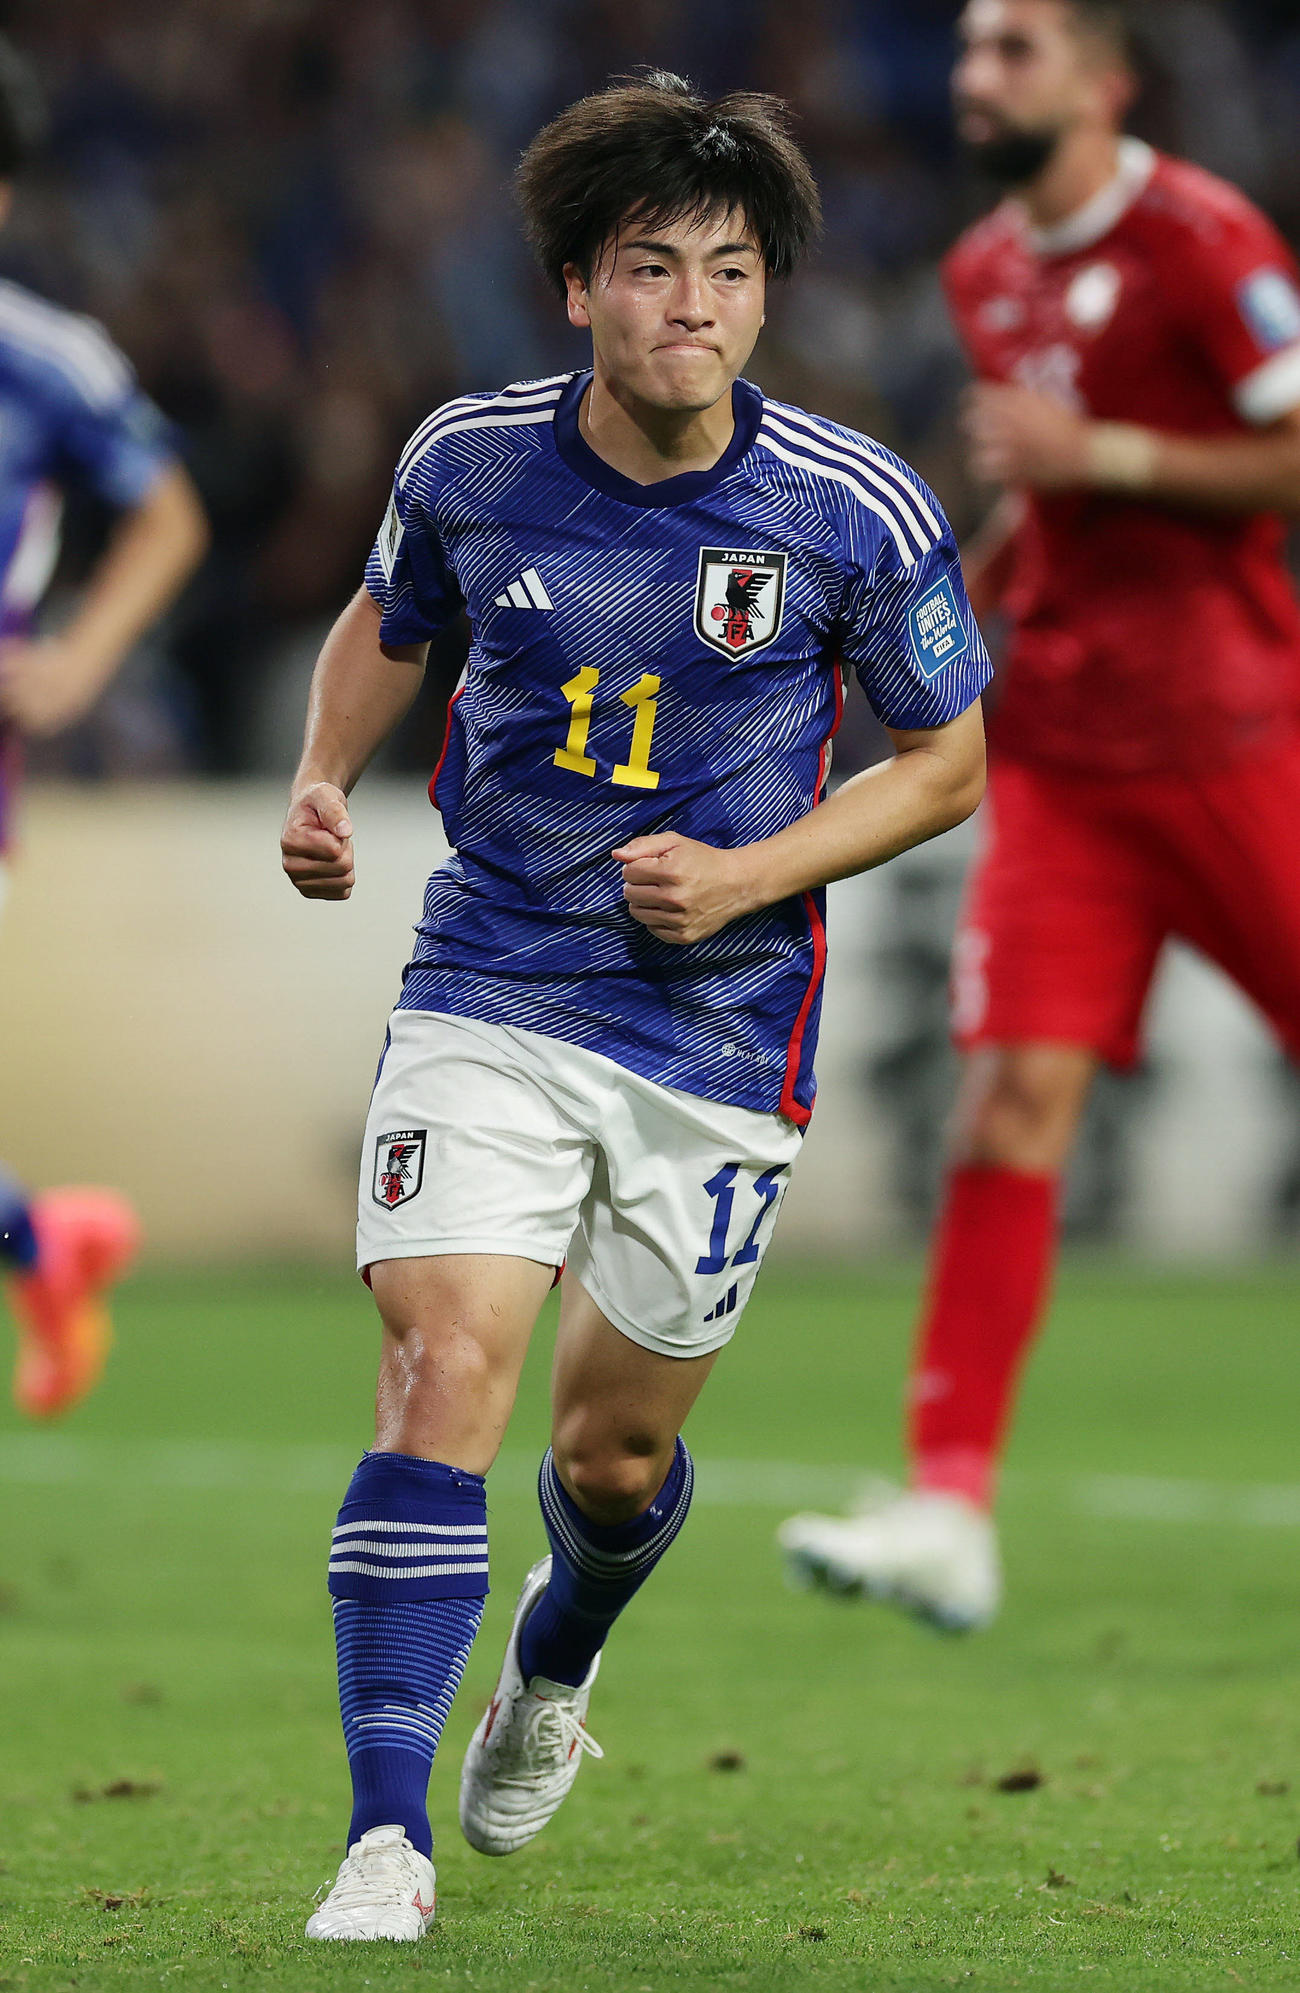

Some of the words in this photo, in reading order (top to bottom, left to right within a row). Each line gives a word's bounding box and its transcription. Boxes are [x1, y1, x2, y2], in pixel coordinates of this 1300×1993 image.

[721, 552, 765, 564] JAPAN
[916, 591, 947, 621] FOOTBALL
[917, 601, 951, 636] UNITES
[717, 622, 755, 641] JFA
[921, 635, 934, 651] the
[932, 613, 957, 641] World
[936, 639, 951, 653] FIFA
[553, 665, 661, 790] 11
[385, 1131, 414, 1142] JAPAN
[381, 1184, 406, 1199] JFA
[694, 1162, 791, 1275] 11
